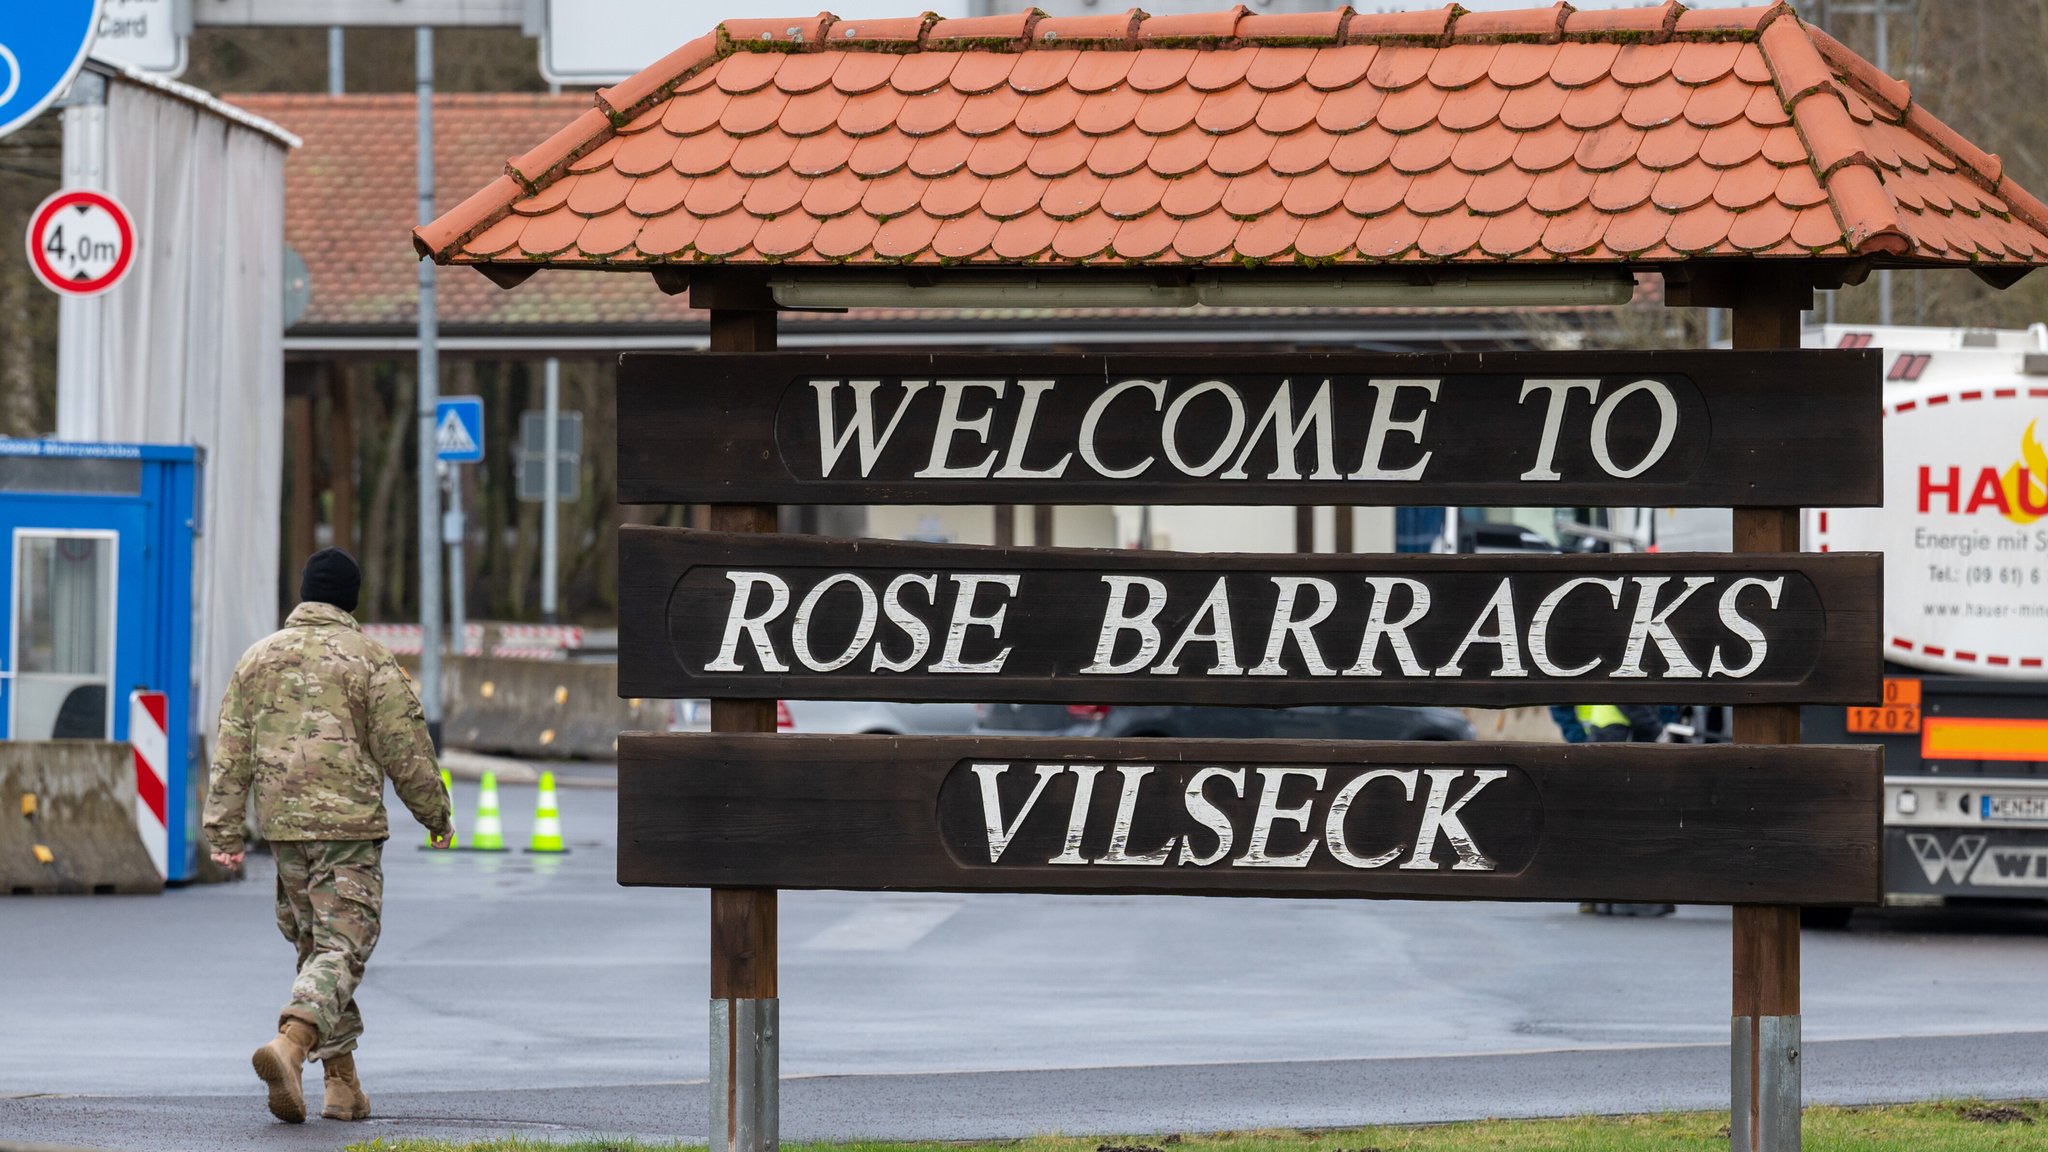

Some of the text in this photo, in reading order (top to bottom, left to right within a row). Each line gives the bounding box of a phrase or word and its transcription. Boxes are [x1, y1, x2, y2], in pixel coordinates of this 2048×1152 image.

[97, 13, 147, 38] Card
[46, 223, 117, 269] 4,0m
[808, 379, 1678, 481] WELCOME TO
[1917, 465, 2048, 516] HAU
[1914, 527, 2048, 557] Energie mit S
[703, 570, 1785, 679] ROSE BARRACKS
[1855, 709, 1915, 730] 1202
[971, 763, 1508, 872] VILSECK
[1993, 853, 2048, 878] WI
